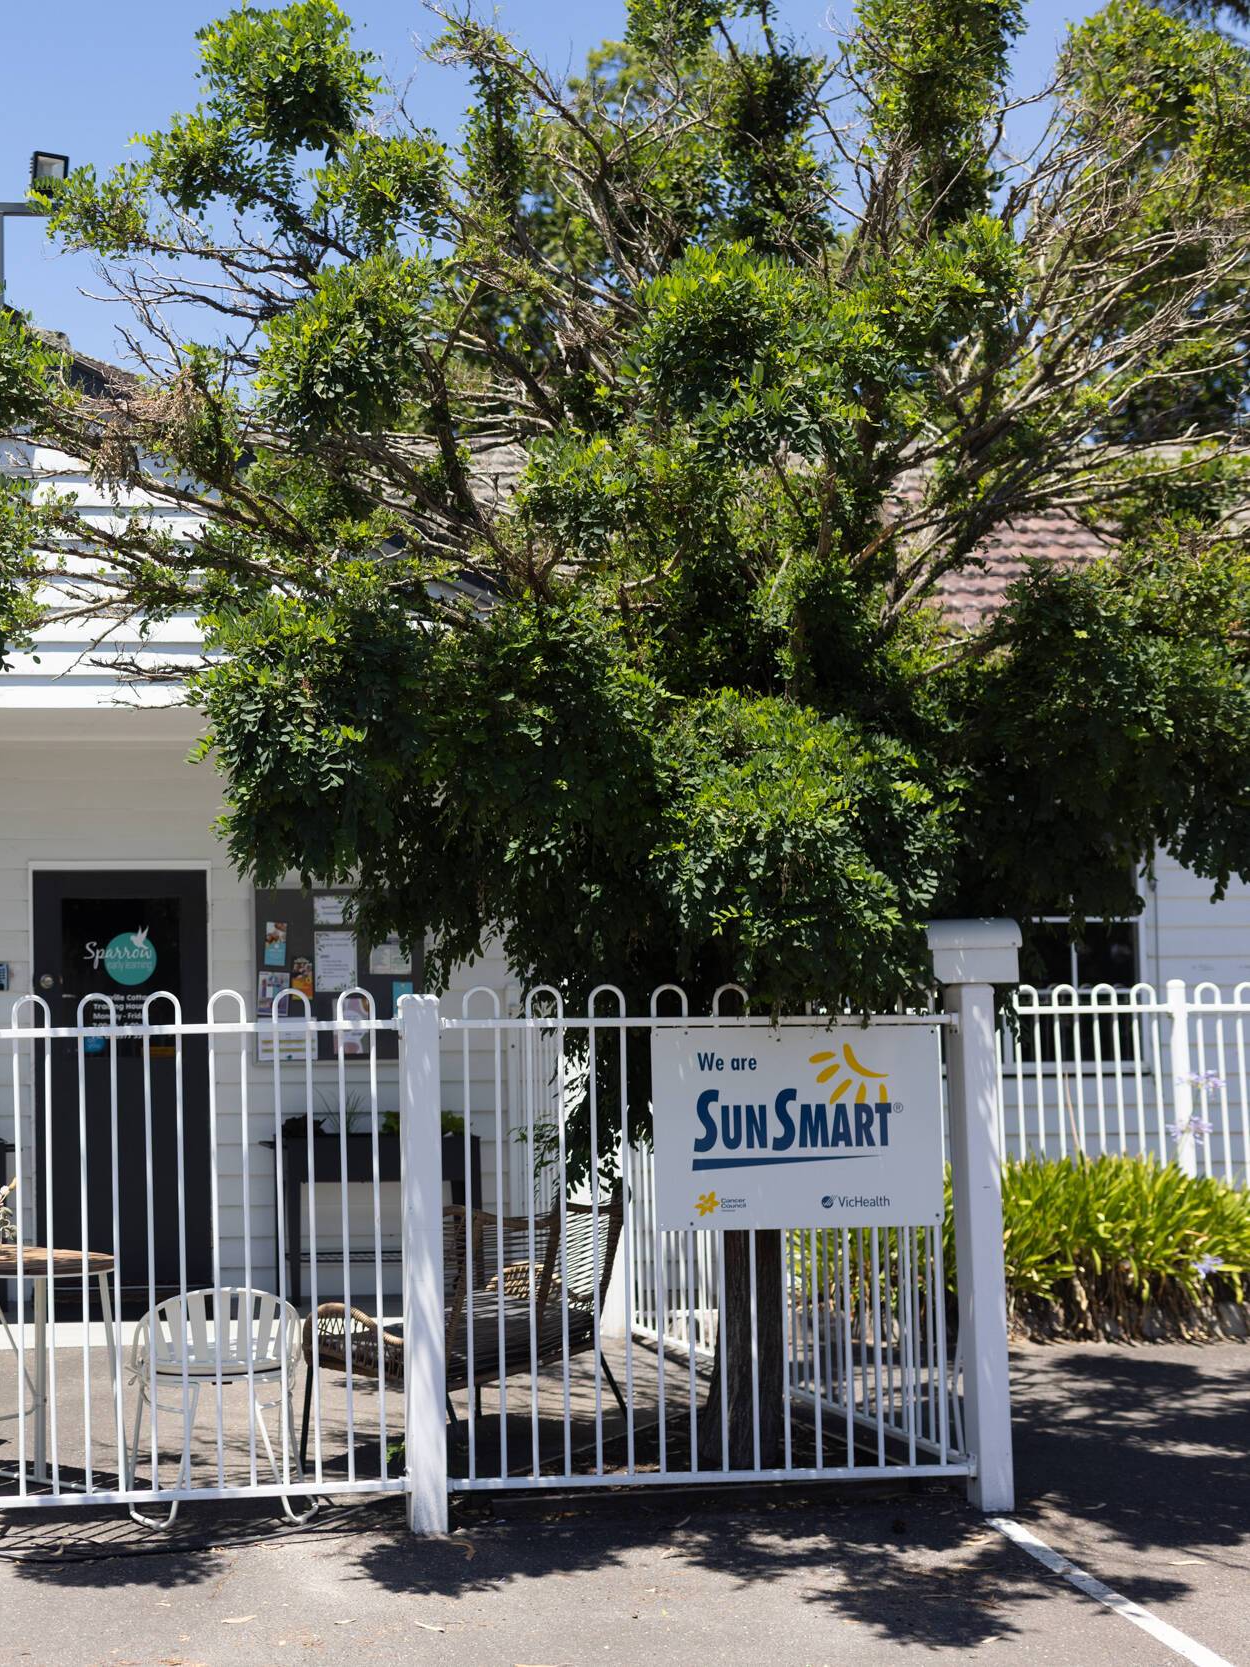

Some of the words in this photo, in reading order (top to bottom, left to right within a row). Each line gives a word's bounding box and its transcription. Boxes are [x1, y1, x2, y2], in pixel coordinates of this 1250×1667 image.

[83, 941, 152, 970] Sparrow
[697, 1052, 725, 1071] We
[731, 1054, 757, 1071] are
[837, 1195, 890, 1208] VicHealth
